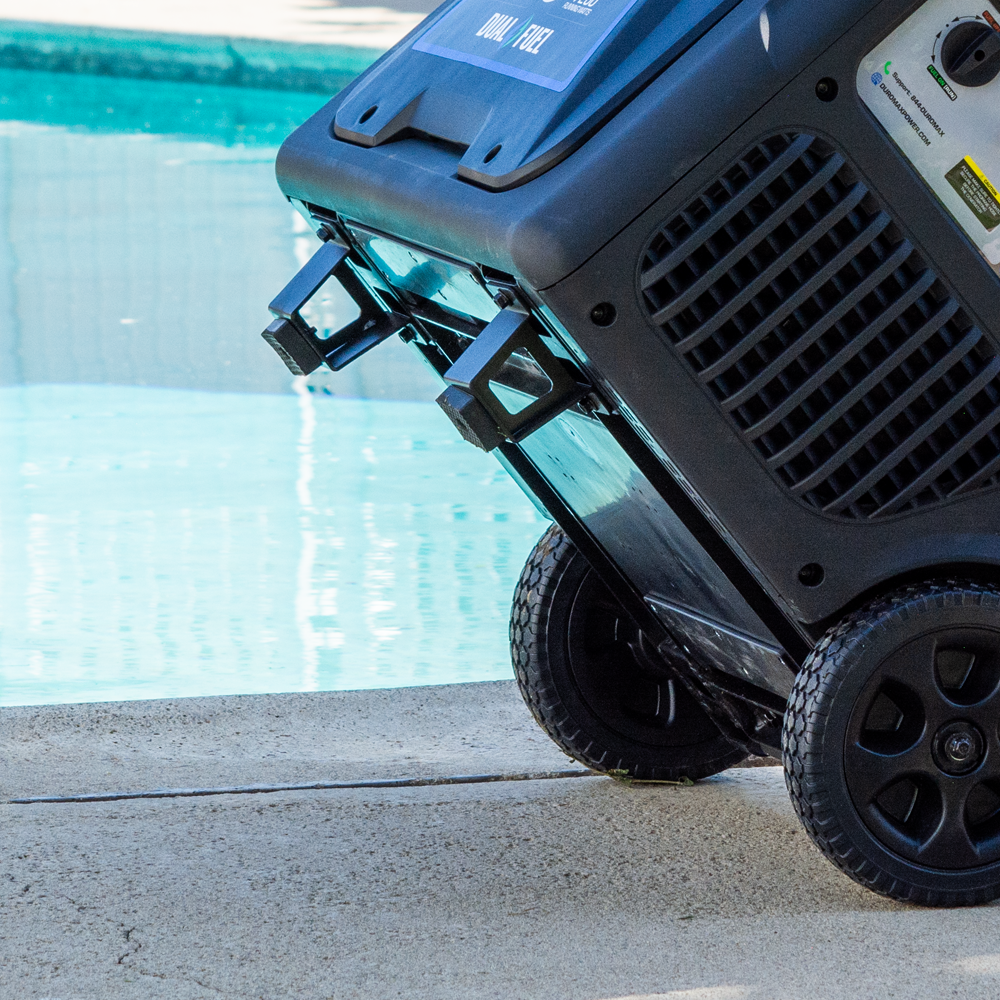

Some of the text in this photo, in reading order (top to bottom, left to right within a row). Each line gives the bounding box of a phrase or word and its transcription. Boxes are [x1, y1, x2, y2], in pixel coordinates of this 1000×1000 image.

[475, 12, 554, 54] DUAL FUEL
[927, 65, 939, 78] FUEL
[937, 76, 945, 86] ON
[878, 82, 931, 147] DUROMAXPOWER.COM
[890, 71, 945, 137] Support: 844-DUROMAX
[983, 178, 997, 196] CAUTION
